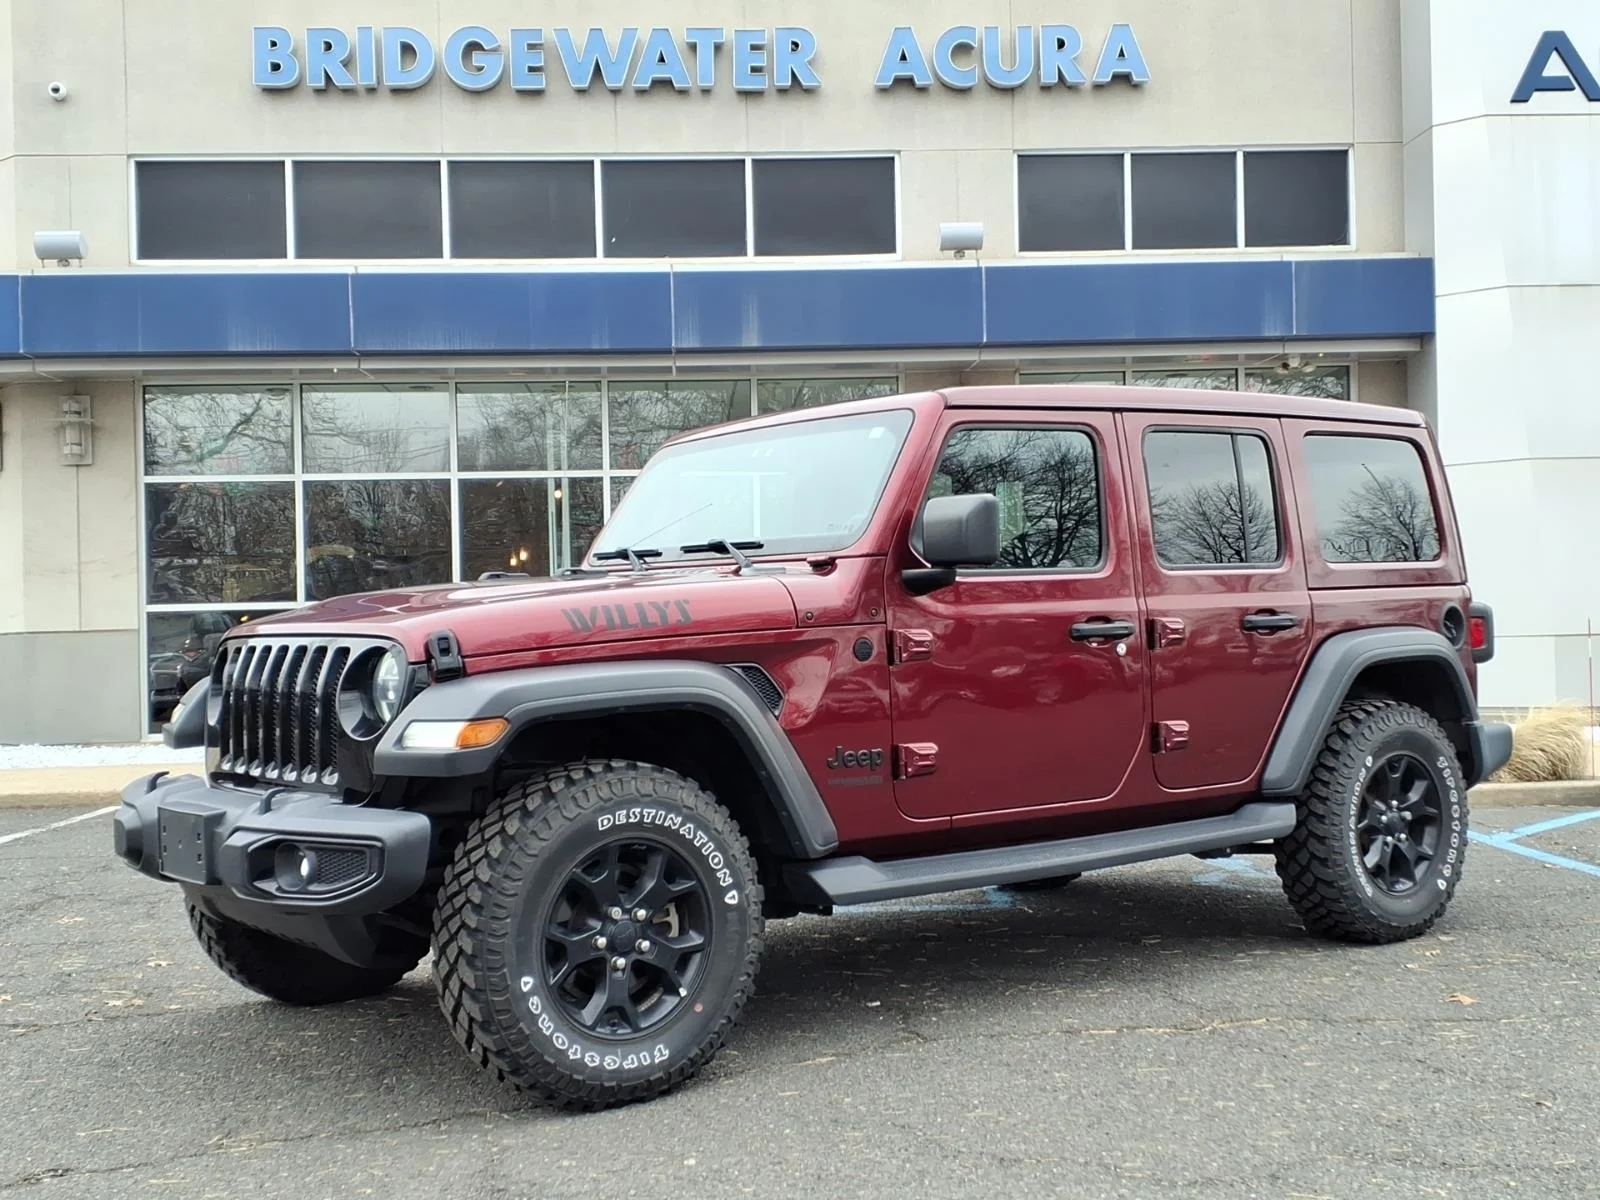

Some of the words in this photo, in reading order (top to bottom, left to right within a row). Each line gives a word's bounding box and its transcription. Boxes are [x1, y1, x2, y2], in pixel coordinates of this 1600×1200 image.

[252, 26, 822, 92] BRIDGEWATER
[874, 23, 1150, 89] ACURA
[561, 599, 692, 634] WILLYS
[827, 745, 883, 772] Jeep
[598, 807, 733, 887] DESTINATION
[528, 995, 670, 1070] Firestone
